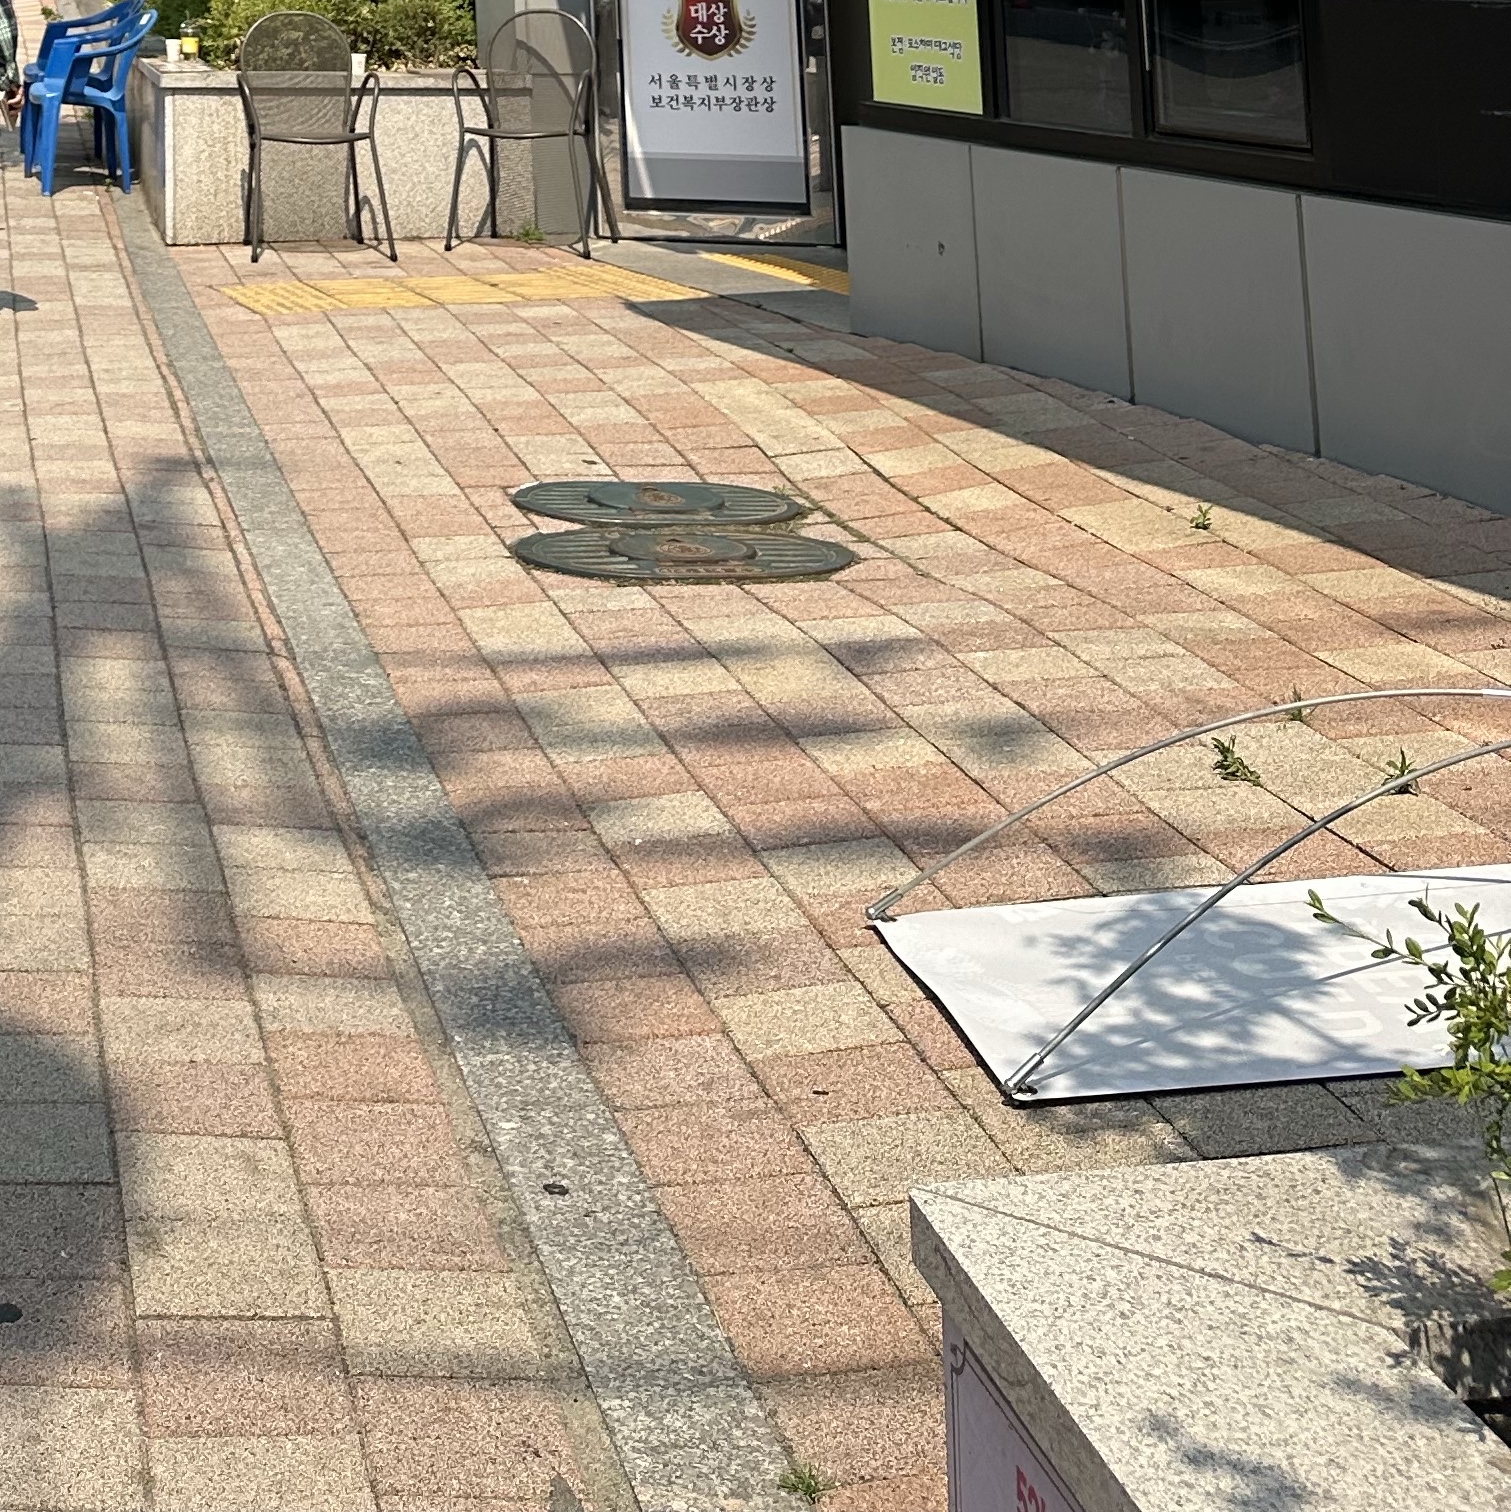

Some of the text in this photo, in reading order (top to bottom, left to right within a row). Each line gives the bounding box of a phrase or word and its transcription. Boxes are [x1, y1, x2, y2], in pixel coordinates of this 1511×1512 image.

[689, 1, 728, 23] 대상
[690, 23, 729, 45] 수상
[648, 72, 776, 93] 서울특별시장상
[649, 94, 776, 115] 보건복지부장관상
